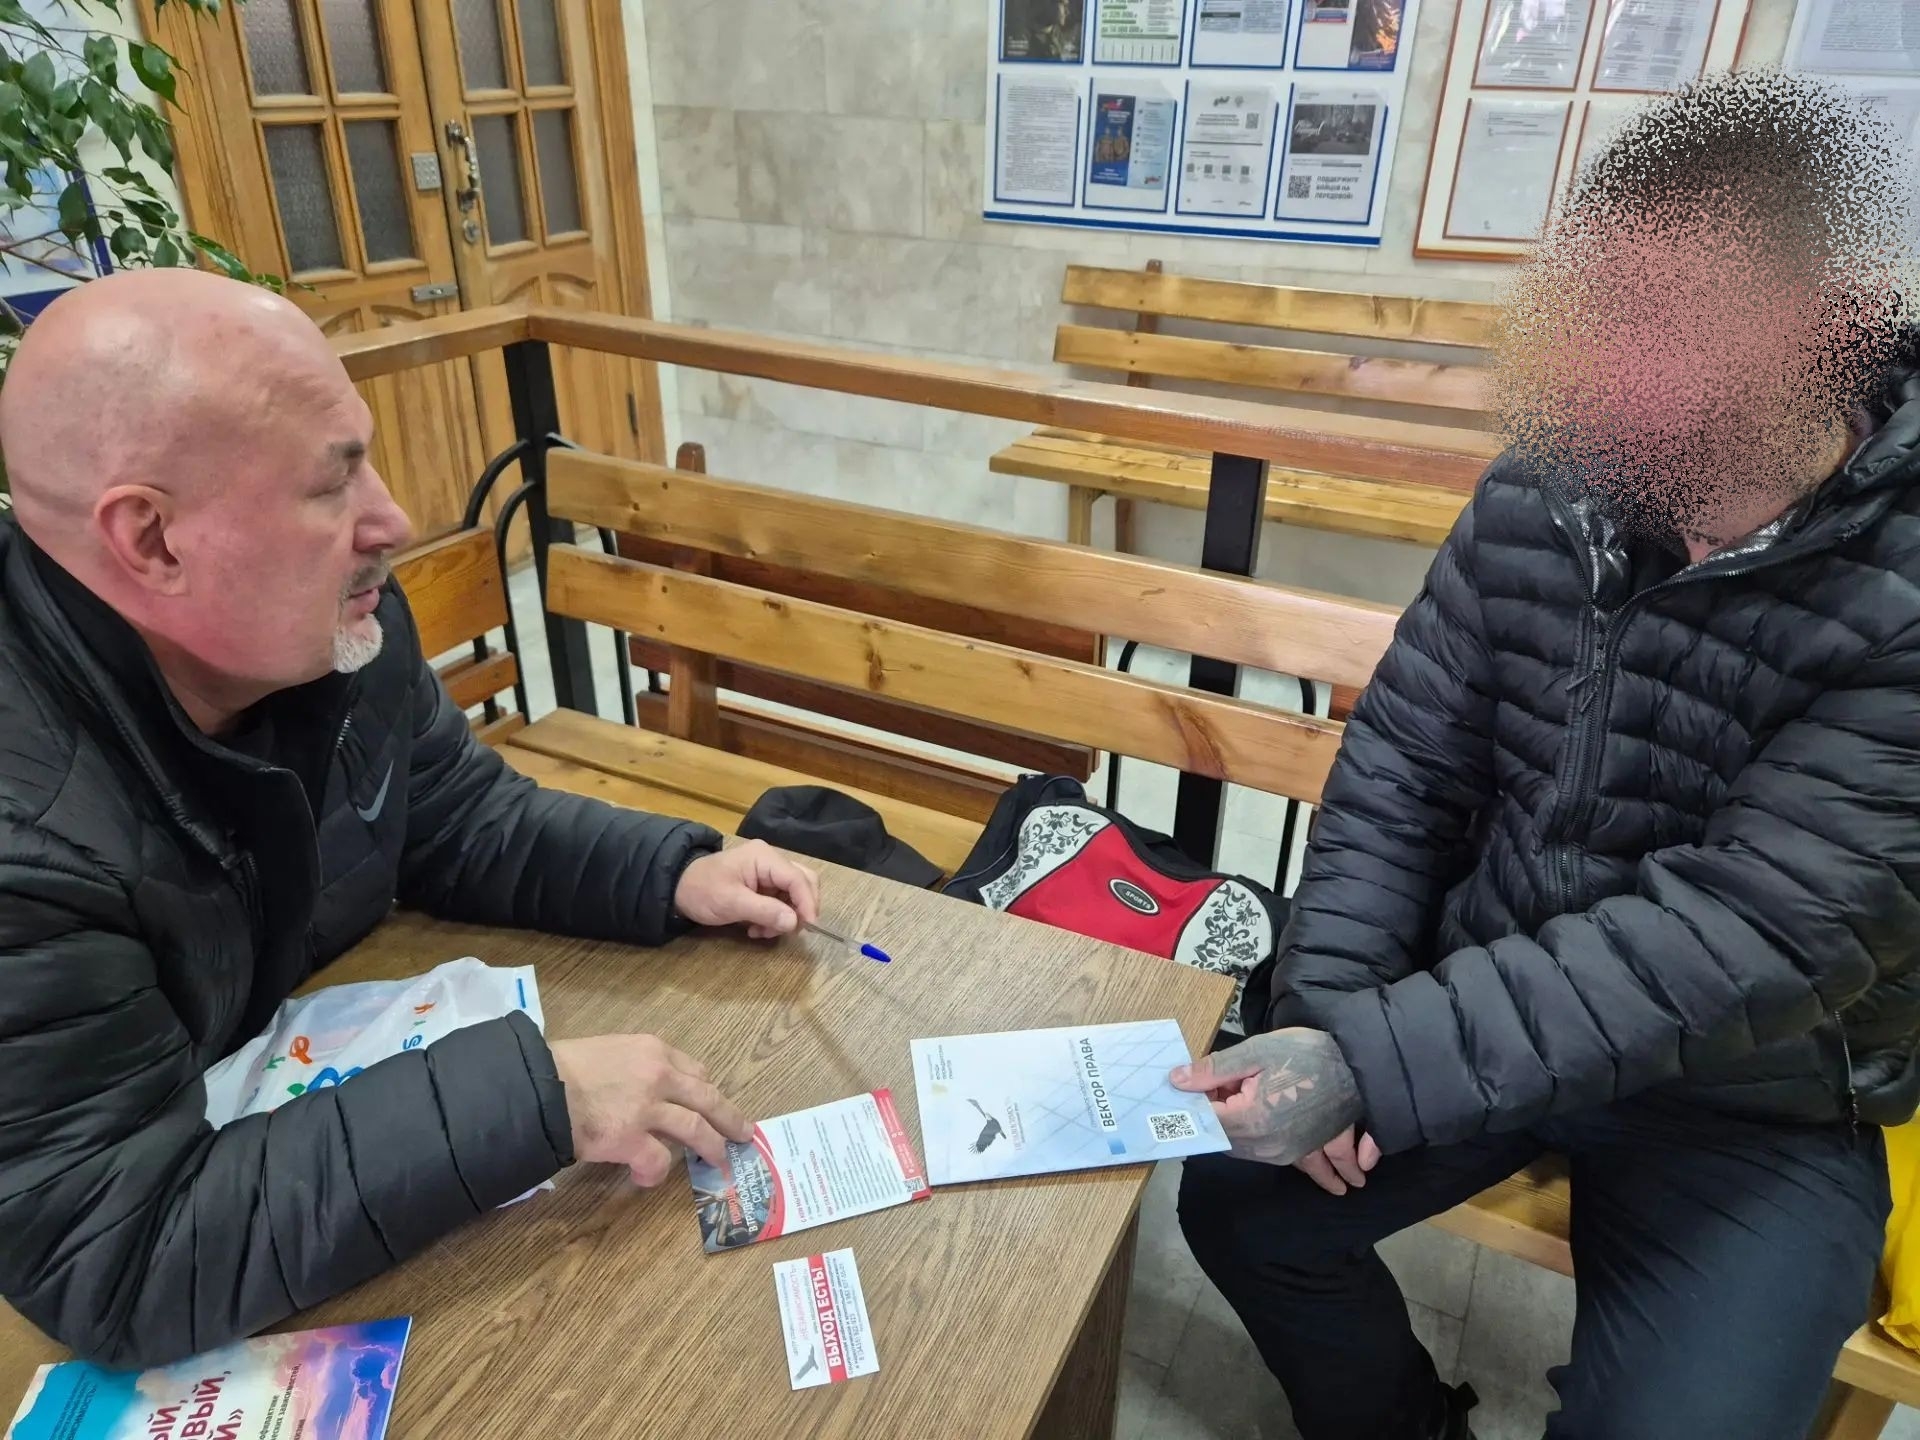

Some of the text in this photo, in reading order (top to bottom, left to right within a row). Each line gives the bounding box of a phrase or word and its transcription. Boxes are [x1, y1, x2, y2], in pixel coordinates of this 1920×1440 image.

[1125, 891, 1151, 909] SPORTS
[1080, 1037, 1098, 1078] ПРАВА
[1091, 1081, 1114, 1126] ВЕКТОР
[811, 1267, 841, 1367] ВЫХОД ЕСТЬ!
[180, 1370, 232, 1440] ВЫЙ,
